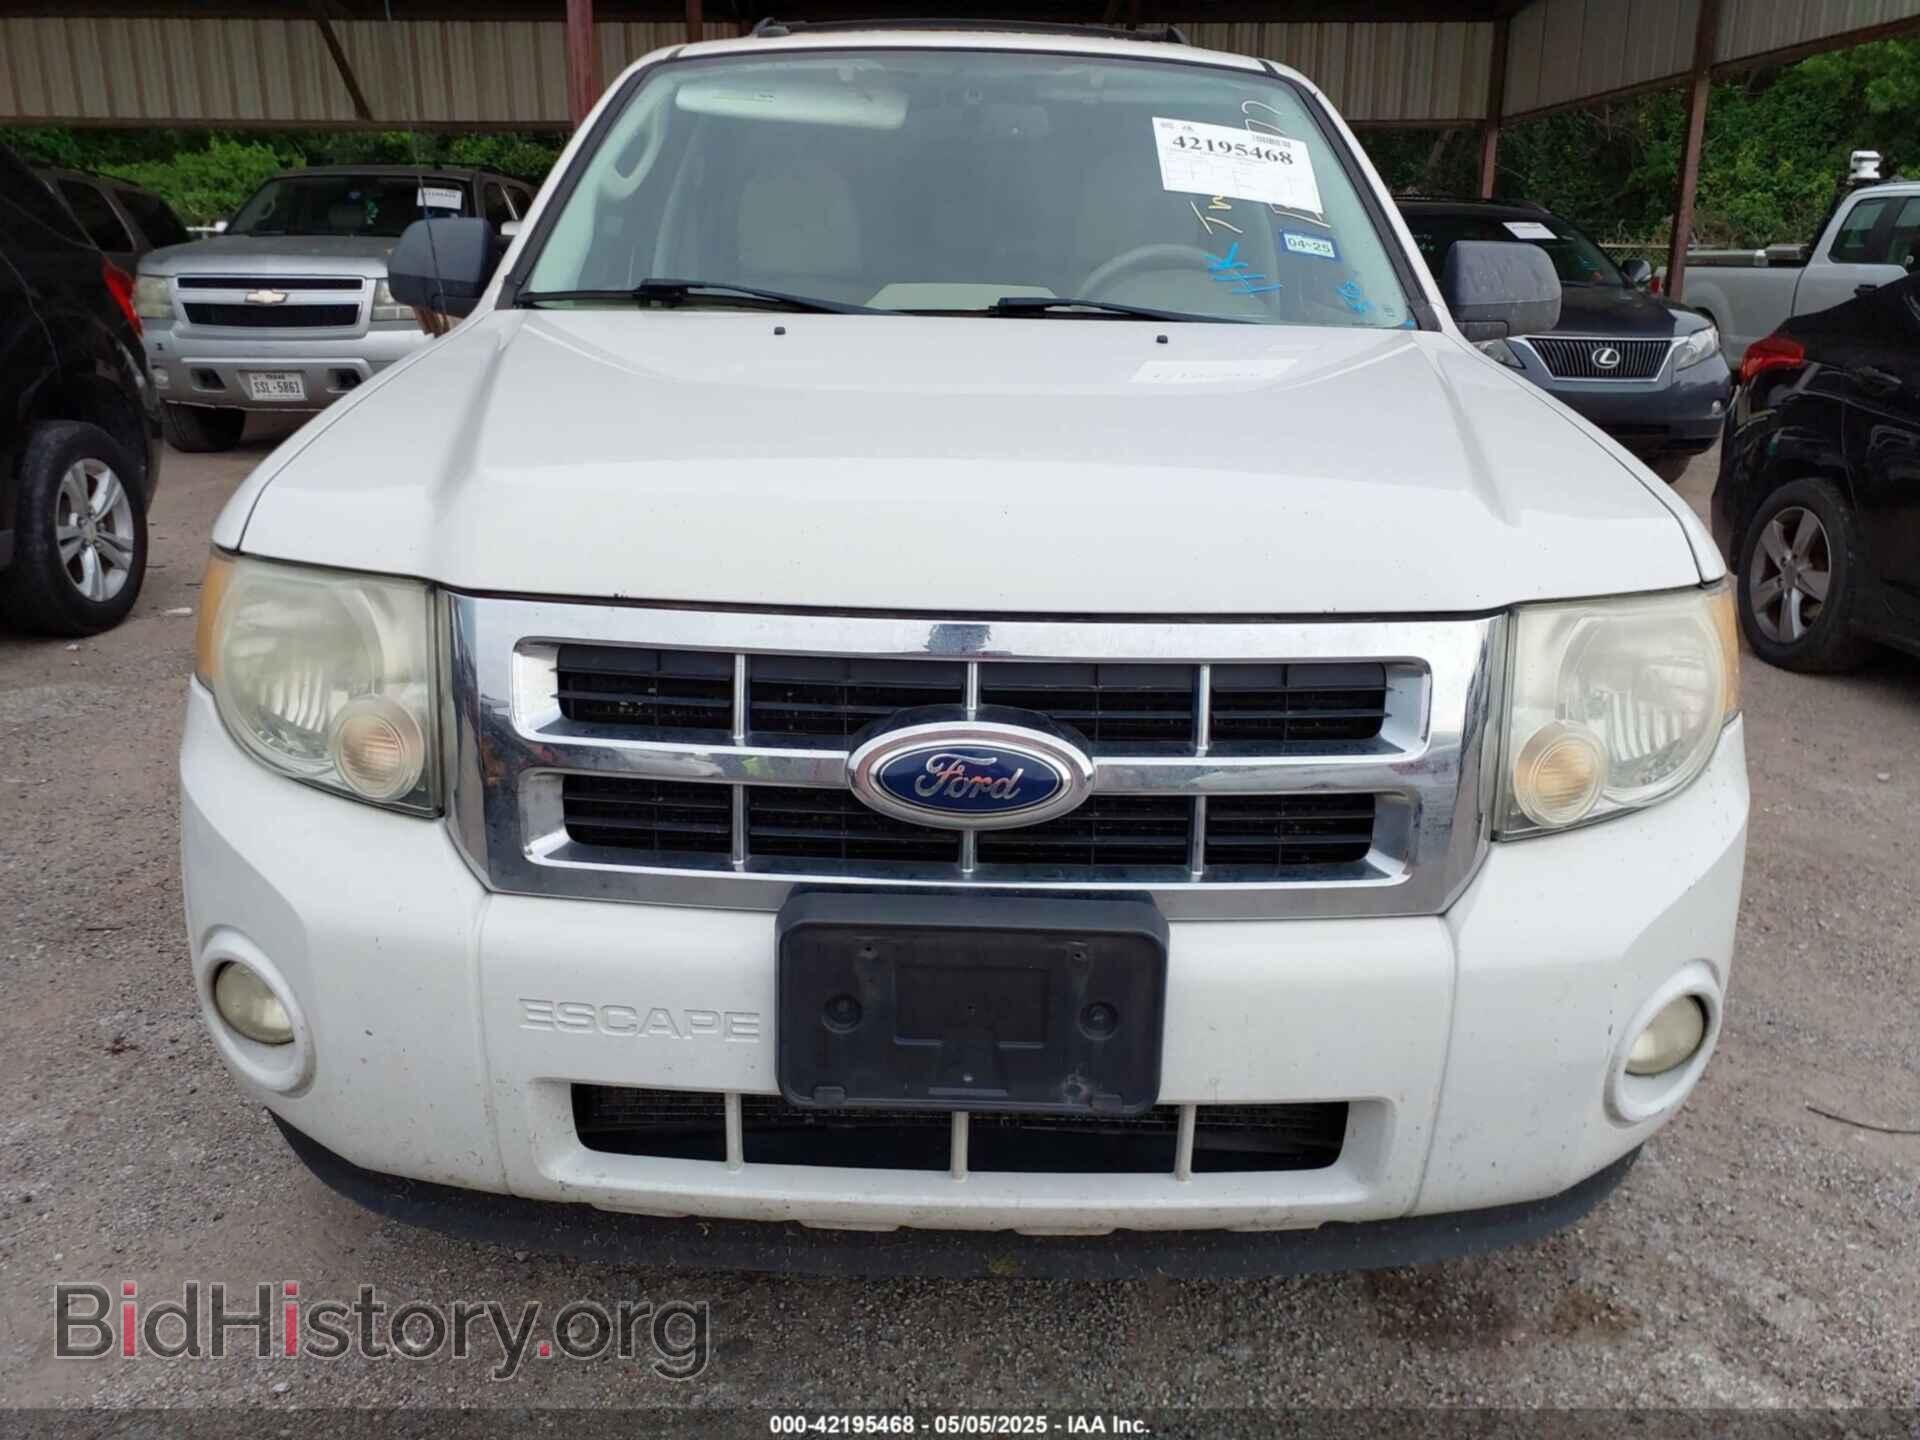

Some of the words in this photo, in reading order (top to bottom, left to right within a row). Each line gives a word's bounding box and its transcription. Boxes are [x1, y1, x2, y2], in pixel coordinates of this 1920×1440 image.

[1172, 135, 1294, 166] 42195468
[914, 753, 1025, 800] Ford
[518, 997, 761, 1043] ESCAPE
